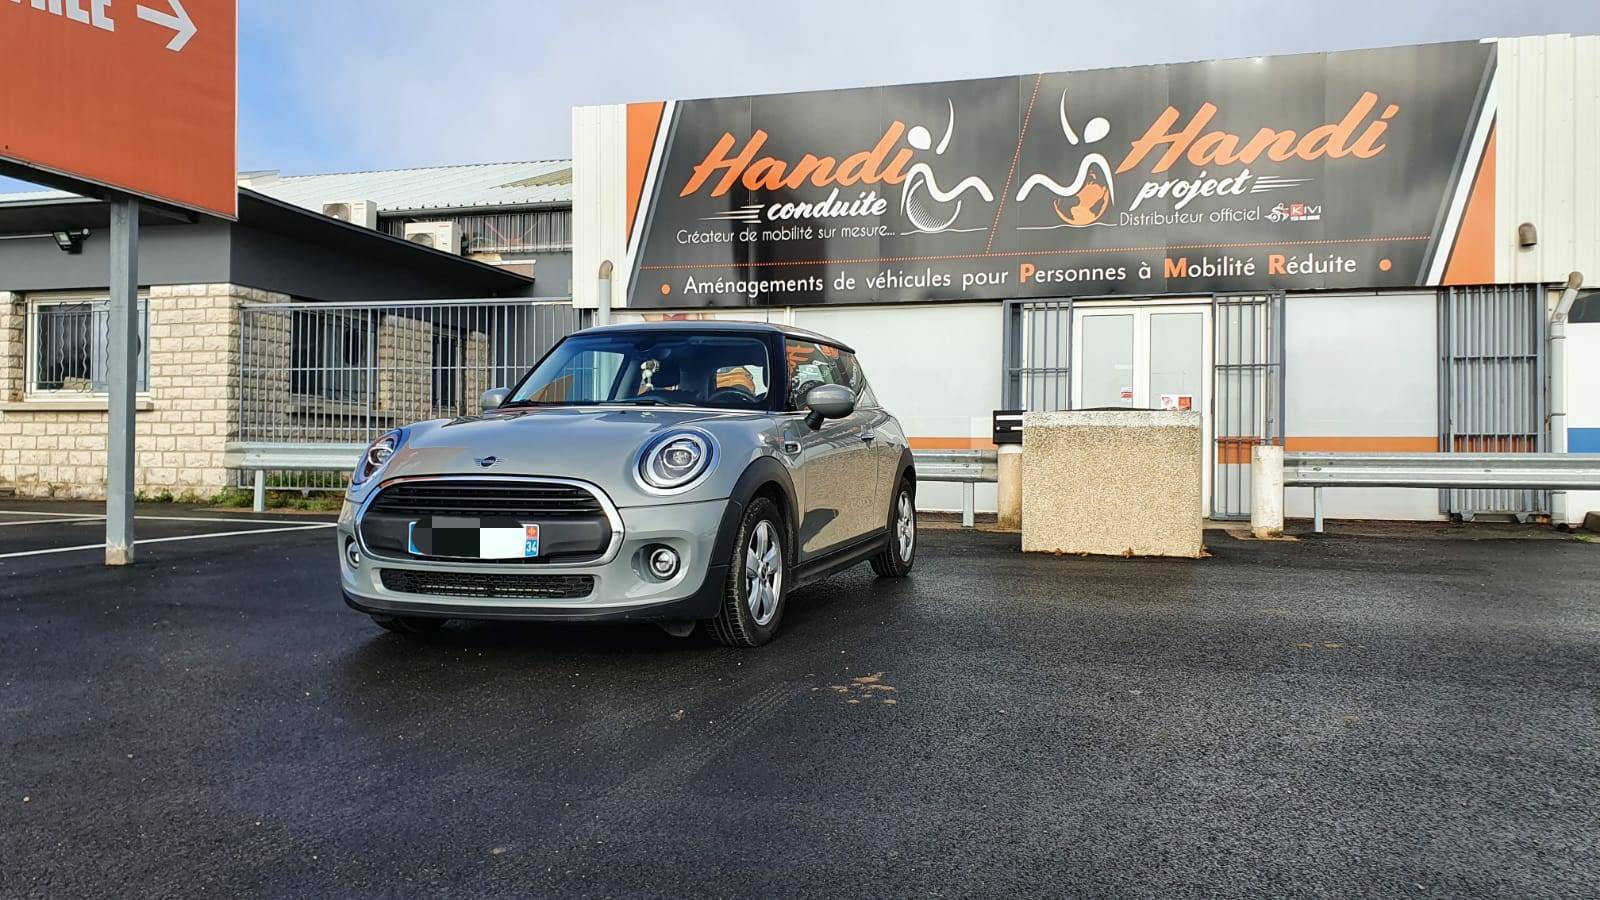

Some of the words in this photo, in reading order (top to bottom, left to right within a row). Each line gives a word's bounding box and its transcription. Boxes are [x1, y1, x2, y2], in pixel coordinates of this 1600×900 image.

[1115, 91, 1400, 174] Handi
[679, 120, 914, 197] Handi
[766, 188, 888, 221] conduite
[1129, 168, 1253, 212] project
[1120, 209, 1204, 226] Distributeur
[1209, 206, 1260, 223] officiel
[1291, 205, 1322, 216] KIVI
[676, 229, 735, 245] Créateur
[739, 226, 758, 242] de
[762, 225, 813, 241] mobilité
[818, 226, 836, 239] sur
[683, 275, 824, 298] Aménagements
[834, 271, 856, 290] de
[866, 266, 952, 289] véhicules
[962, 270, 1009, 292] pour
[1020, 263, 1126, 284] Personnes
[1138, 261, 1152, 279] à
[1164, 255, 1256, 279] Mobilité
[1268, 254, 1357, 275] Réduite
[526, 540, 537, 553] 34
